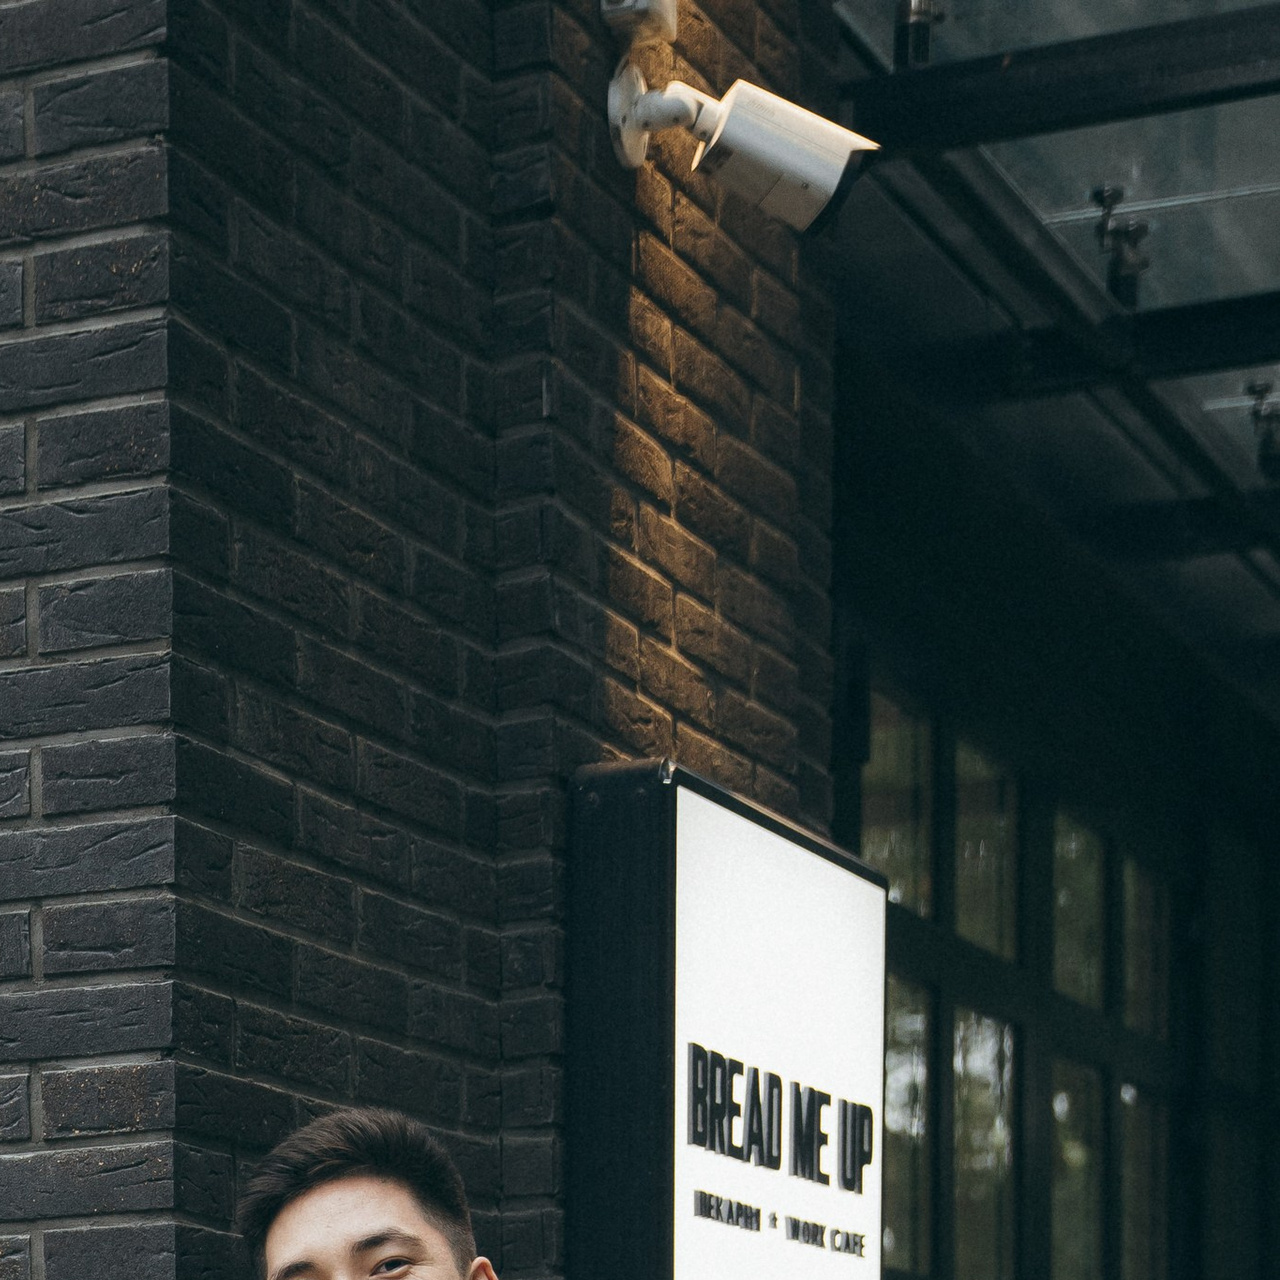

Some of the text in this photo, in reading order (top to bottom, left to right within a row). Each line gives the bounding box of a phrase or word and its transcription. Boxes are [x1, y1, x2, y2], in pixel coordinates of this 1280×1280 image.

[687, 1042, 874, 1195] BREAD ME UP
[784, 1215, 827, 1249] WORK
[829, 1228, 865, 1258] CAFE
